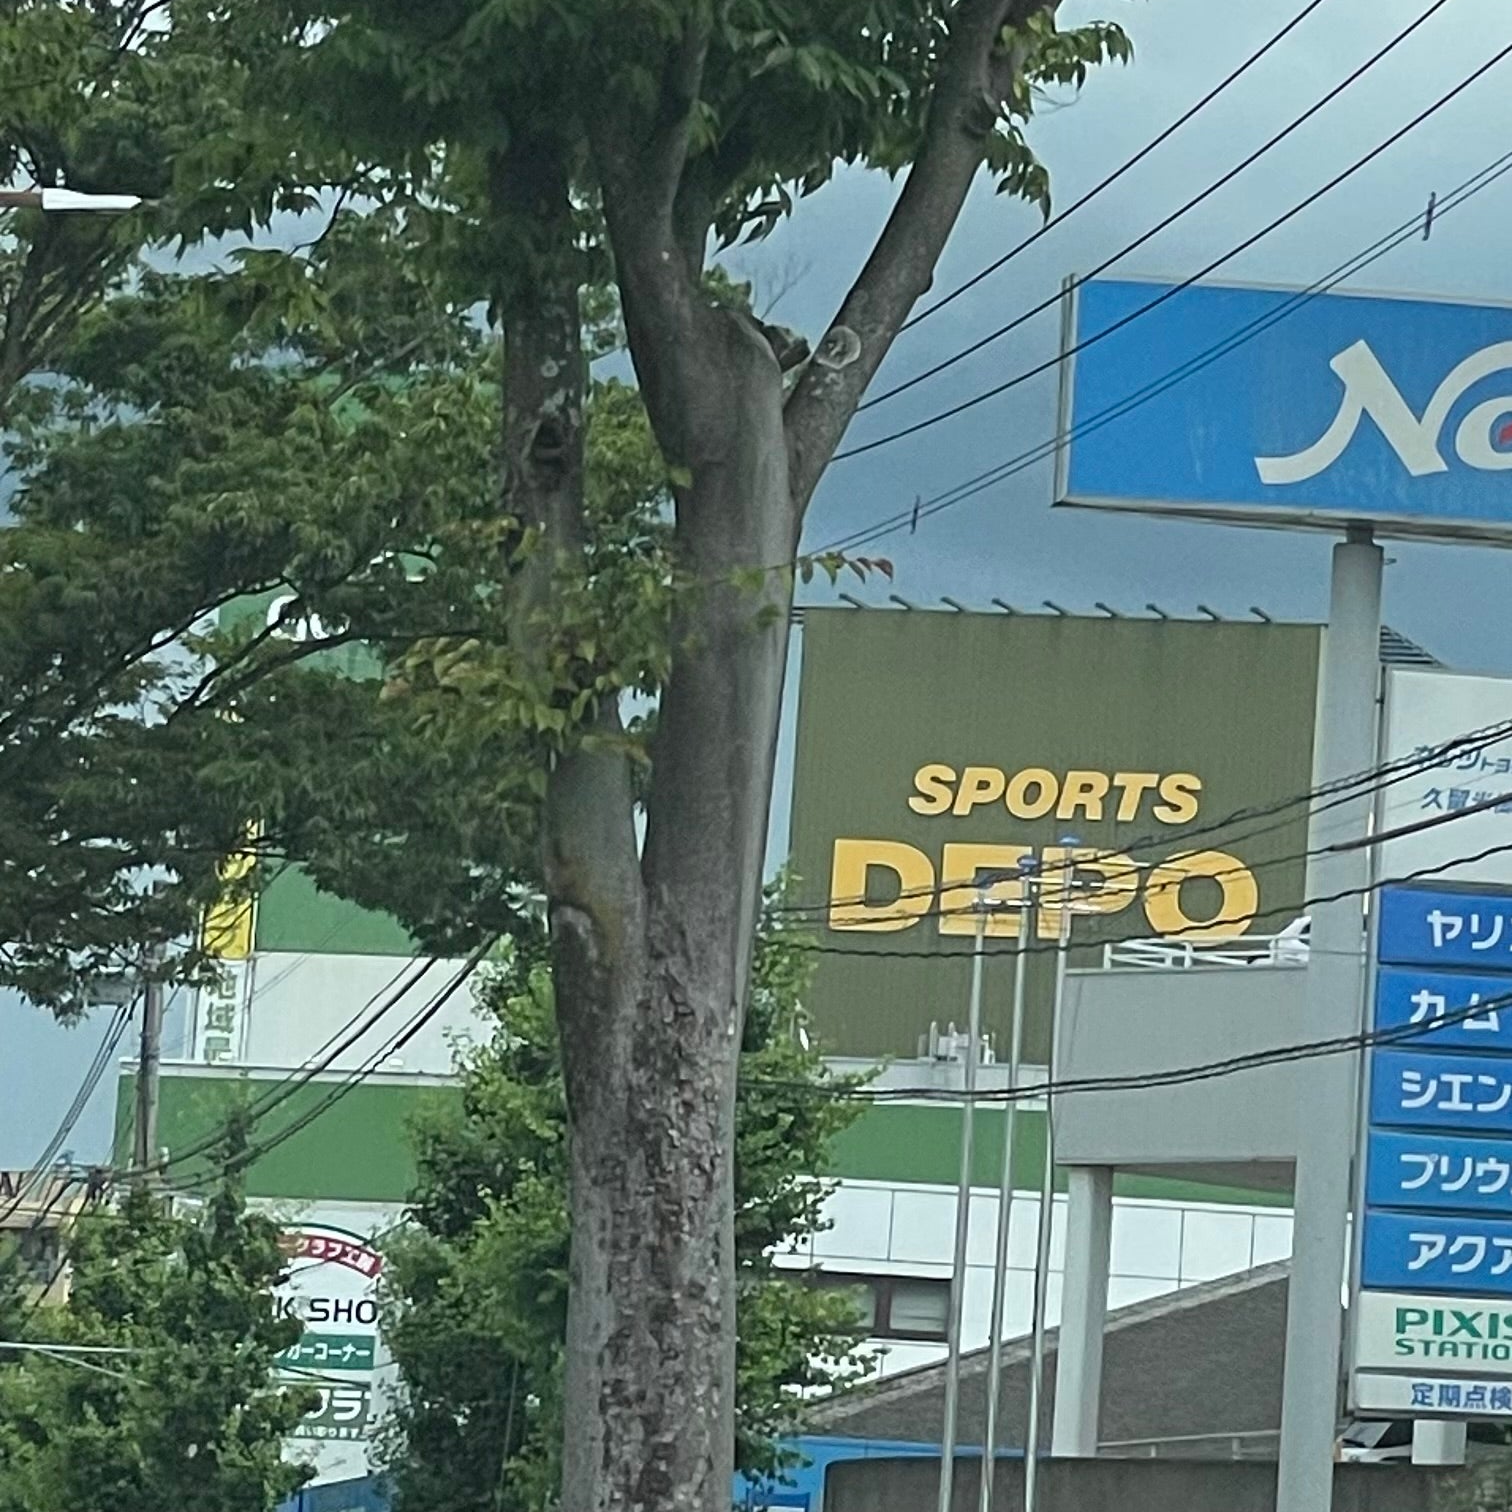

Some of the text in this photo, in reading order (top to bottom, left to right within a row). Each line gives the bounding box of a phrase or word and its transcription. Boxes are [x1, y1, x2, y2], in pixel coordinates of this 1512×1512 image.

[908, 764, 1202, 824] SPORTS
[828, 838, 1260, 947] DEPO
[1411, 1382, 1512, 1411] 定期点検
